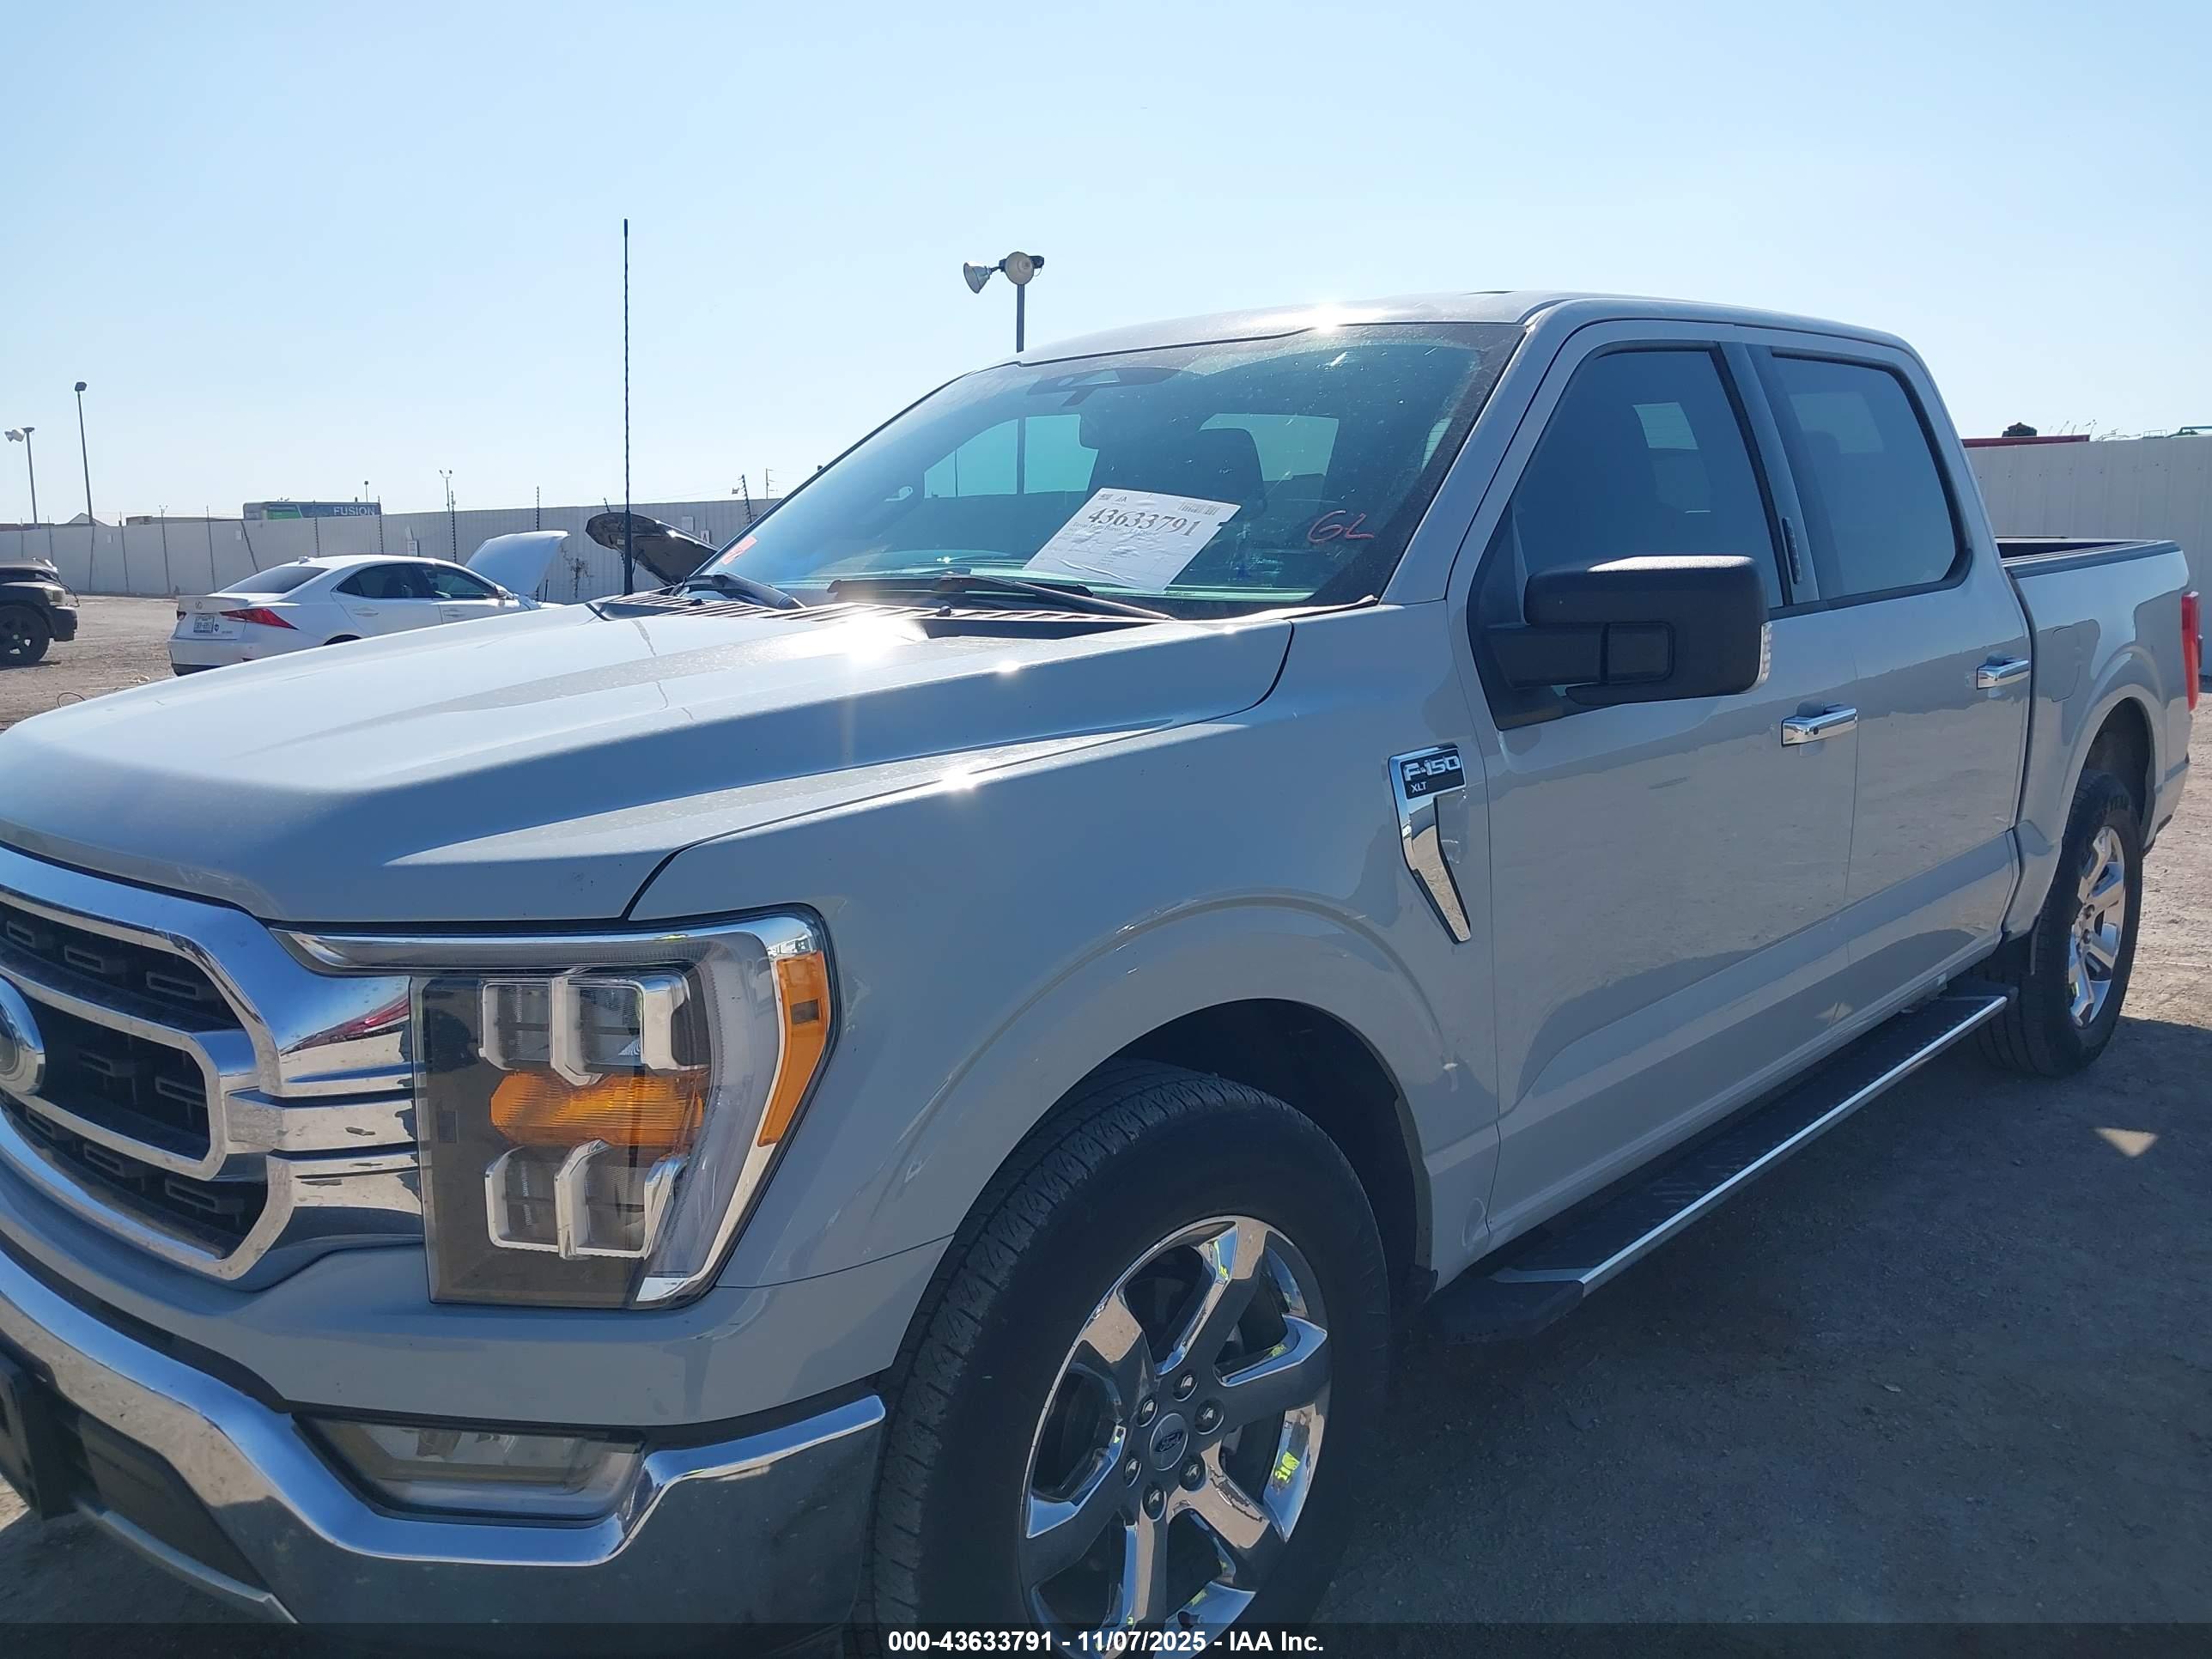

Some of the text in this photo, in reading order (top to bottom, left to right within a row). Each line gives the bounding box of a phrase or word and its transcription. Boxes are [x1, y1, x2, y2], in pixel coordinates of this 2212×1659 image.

[1087, 507, 1201, 537] 43633791
[1403, 756, 1461, 781] F-150
[1411, 781, 1427, 793] XLT
